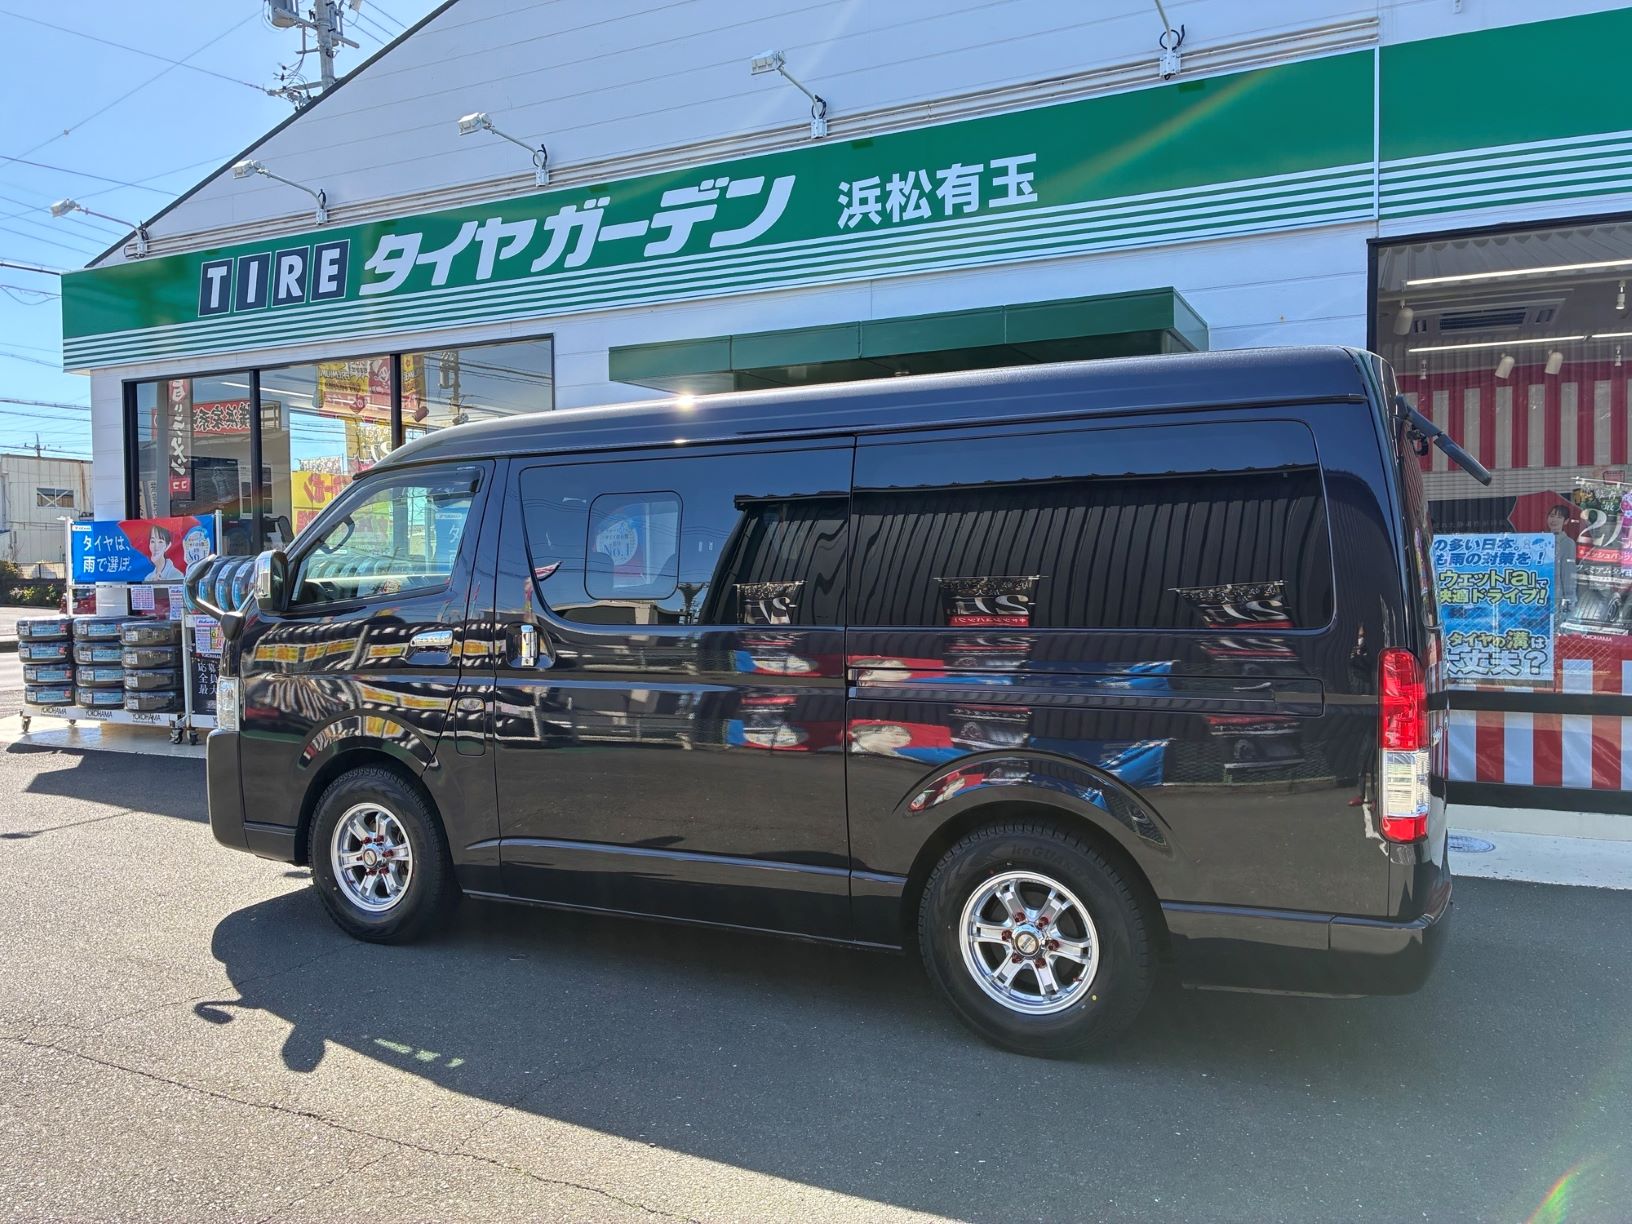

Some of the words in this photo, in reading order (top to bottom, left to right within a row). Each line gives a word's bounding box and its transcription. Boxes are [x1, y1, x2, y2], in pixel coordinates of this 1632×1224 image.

[206, 250, 341, 309] TIRE
[358, 175, 796, 296] タイヤガーデン
[837, 152, 1040, 229] 浜松有玉
[83, 534, 130, 551] タイヤは、
[40, 705, 67, 715] YOKOHAMA
[85, 709, 113, 718] YOKOHAMA
[132, 713, 161, 722] YOKOHAMA
